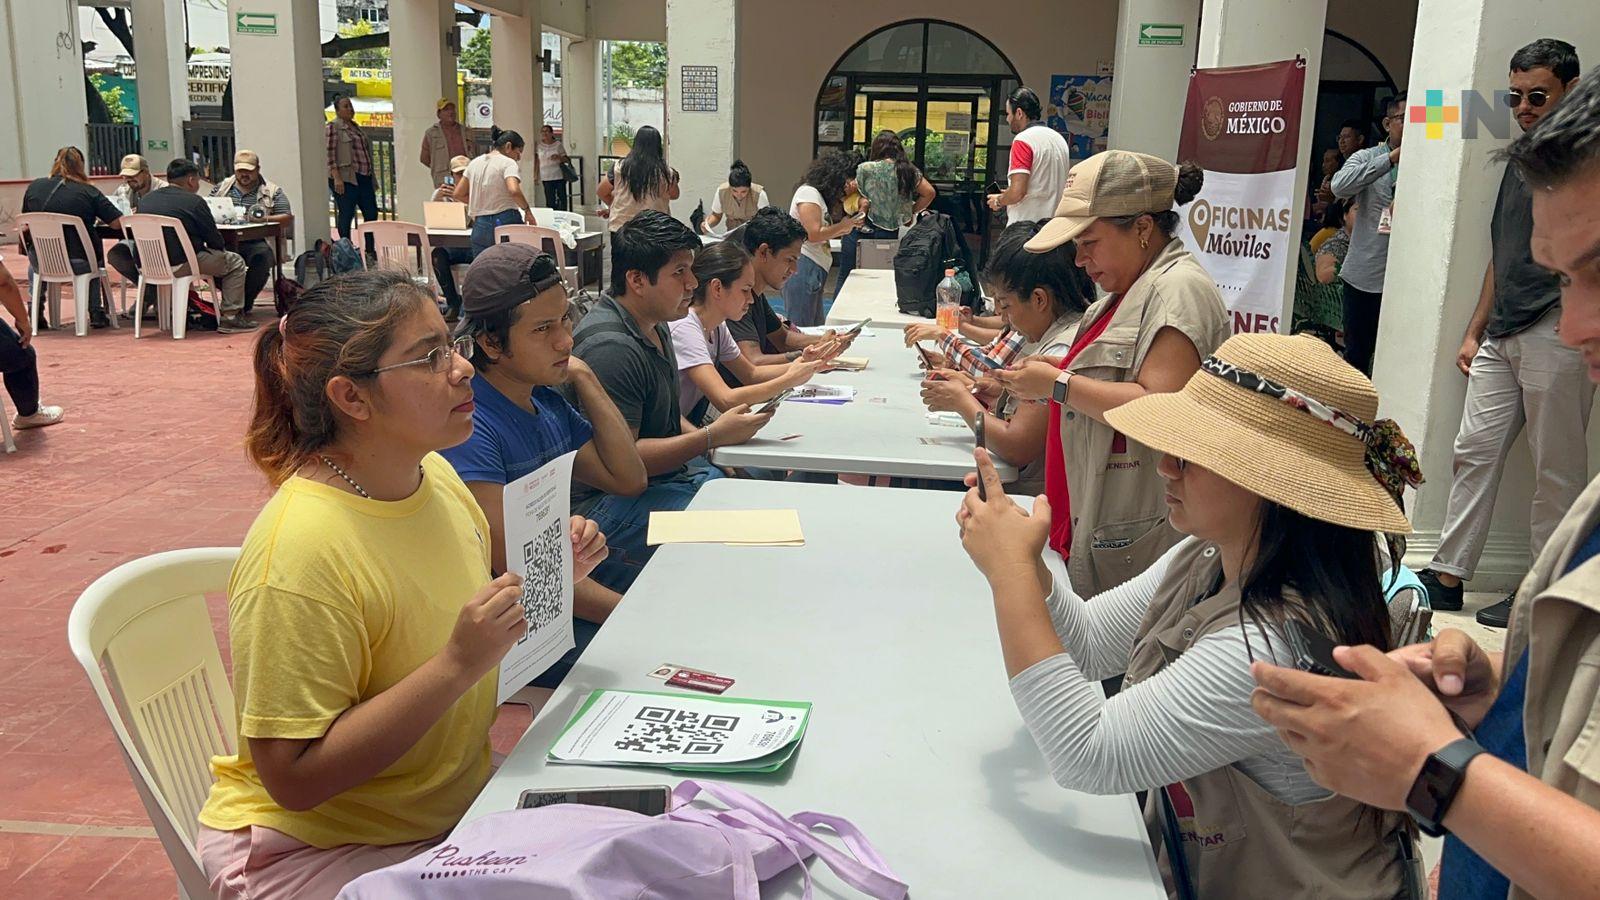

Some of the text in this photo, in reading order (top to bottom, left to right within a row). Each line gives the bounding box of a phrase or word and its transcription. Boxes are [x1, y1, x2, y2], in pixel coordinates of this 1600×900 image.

[1228, 100, 1283, 113] GOBIERNO DE
[1226, 112, 1286, 134] MÉXICO
[1206, 231, 1272, 260] Móviles
[425, 843, 528, 867] Pusheen
[468, 867, 515, 877] THE CAT
